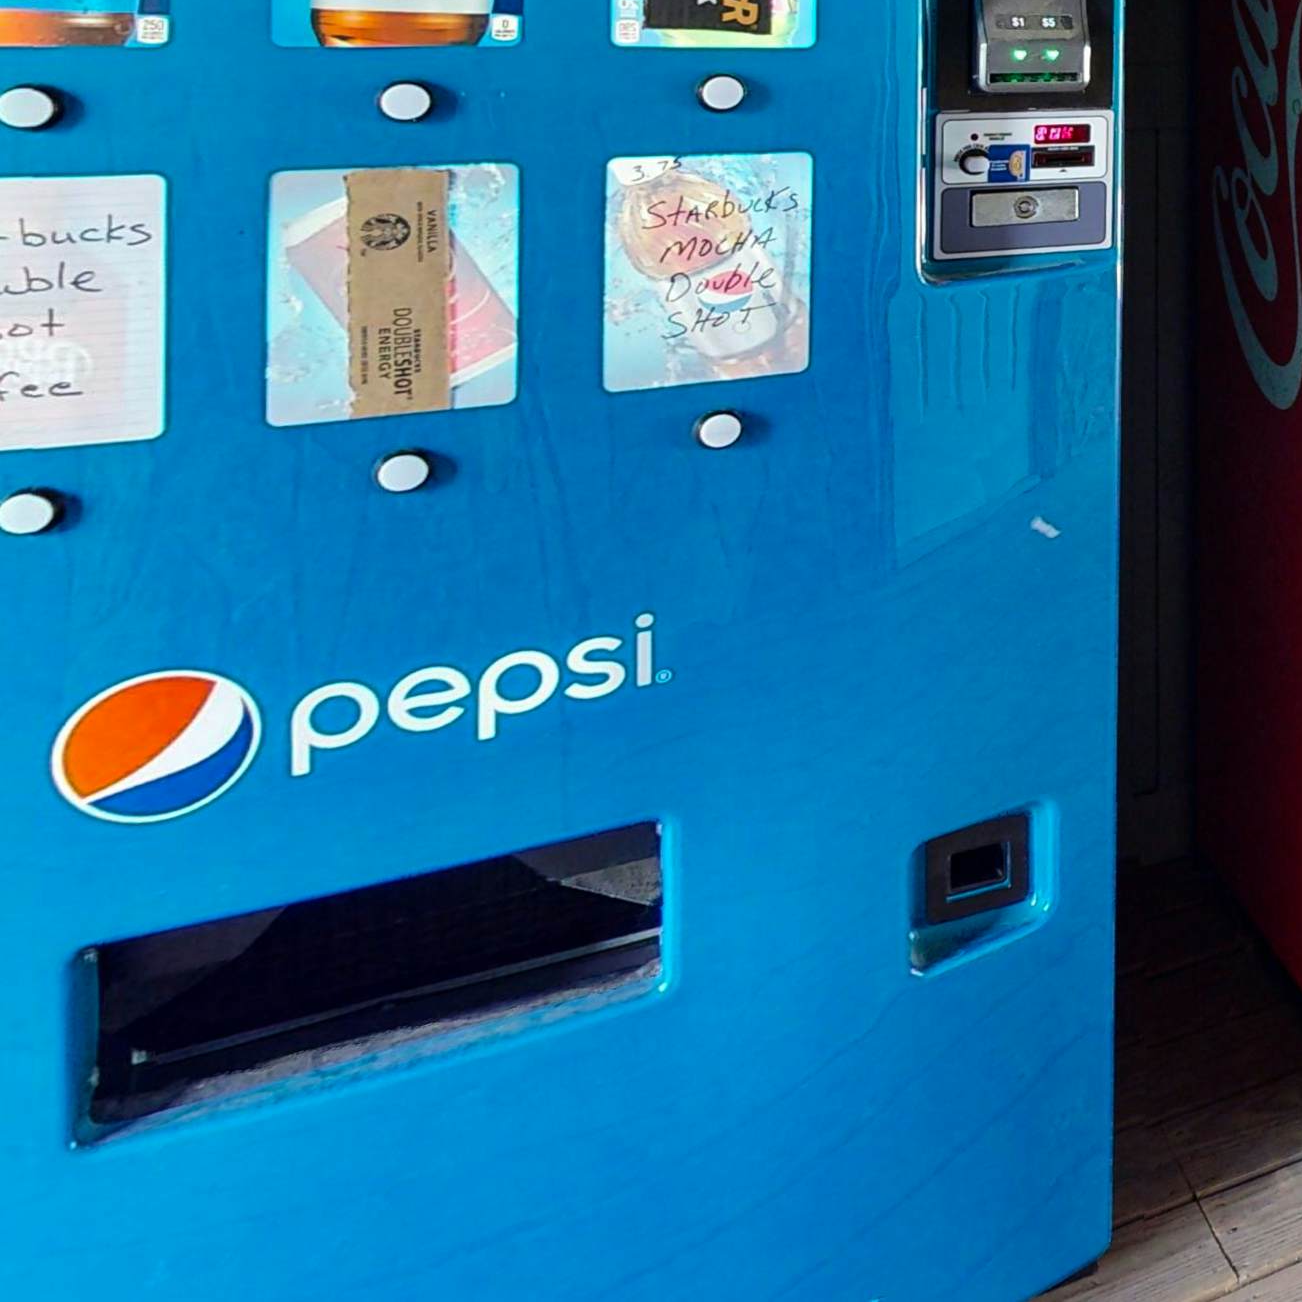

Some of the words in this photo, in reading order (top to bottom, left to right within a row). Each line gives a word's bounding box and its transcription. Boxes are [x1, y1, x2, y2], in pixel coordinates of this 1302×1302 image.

[1011, 16, 1026, 28] $1
[1041, 16, 1057, 29] $5
[3, 214, 153, 247] bucks
[426, 209, 439, 254] VANILLA
[665, 261, 776, 303] Double
[2, 307, 66, 338] ot
[378, 327, 391, 380] ENERGY
[393, 307, 413, 397] DOUBLESHOT
[289, 612, 656, 777] pepsi
